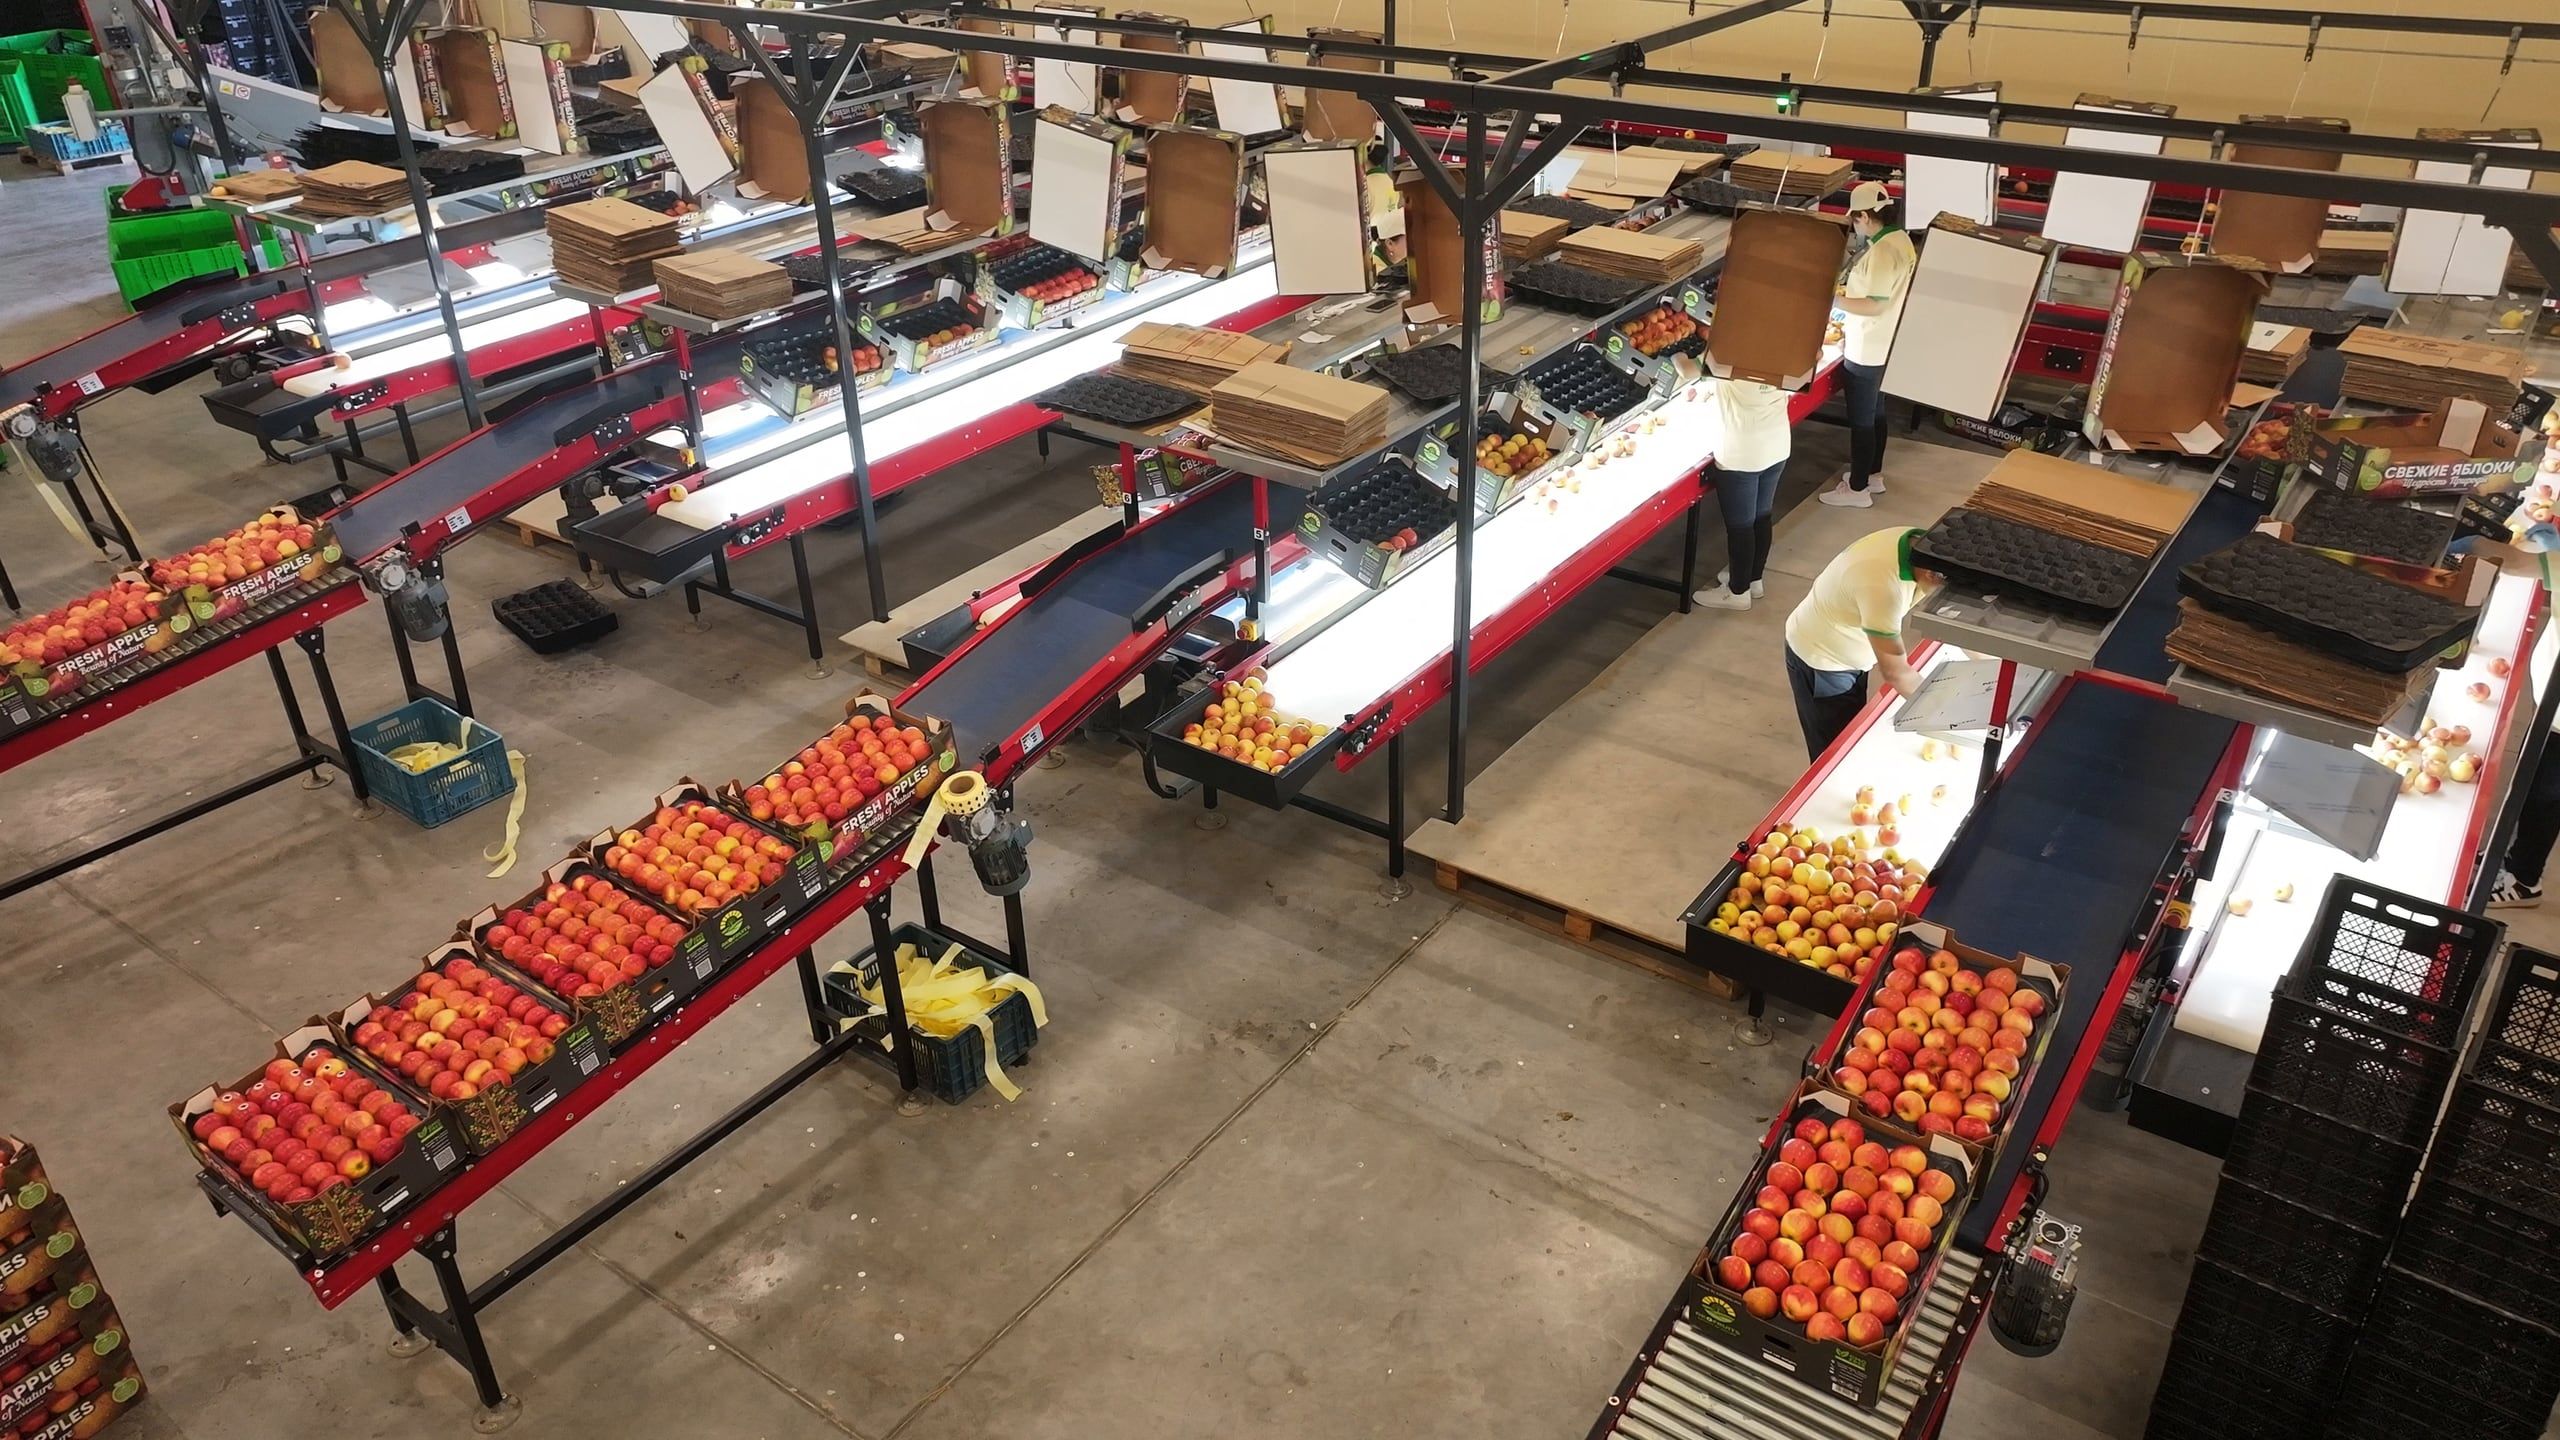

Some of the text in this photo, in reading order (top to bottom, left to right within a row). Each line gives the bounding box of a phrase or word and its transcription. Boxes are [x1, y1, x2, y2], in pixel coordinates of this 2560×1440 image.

[422, 42, 435, 80] СВЕЖИЕ
[429, 81, 442, 116] ЯБЛОКИ
[488, 45, 504, 83] ЯБЛОКИ
[497, 83, 510, 122] СВЕЖИЕ
[556, 59, 570, 101] СВЕЖИЕ
[564, 101, 577, 139] ЯБЛОКИ
[696, 72, 720, 112] СВЕЖИЕ
[832, 107, 851, 117] FRESH
[549, 174, 573, 186] FRESH
[1000, 172, 1010, 216] СВЕЖИЕ
[1486, 249, 1494, 291] FRESH
[932, 342, 957, 357] FRESH
[957, 331, 984, 348] APPLES
[2093, 285, 2130, 416] СВЕЖИЕ ЯБЛОКИ
[1955, 417, 1987, 433] СВЕЖИЕ
[1988, 428, 2022, 443] ЯБЛОКИ
[2384, 460, 2516, 480] СВЕЖИЕ ЯБЛОКИ
[1256, 530, 1262, 539] 5
[222, 553, 313, 600] FRESH APPLES
[241, 571, 300, 601] Bounty of Nature
[56, 624, 159, 676] FRESH APPLES
[78, 642, 145, 676] Bounty of Nature
[1990, 728, 1999, 738] 4
[841, 764, 930, 836] FRESH APPLES
[860, 788, 917, 833] Bounty of Nature
[2222, 790, 2233, 802] 3
[0, 1352, 76, 1411] APPLES
[2, 1406, 14, 1421] of
[16, 1382, 56, 1411] Nature
